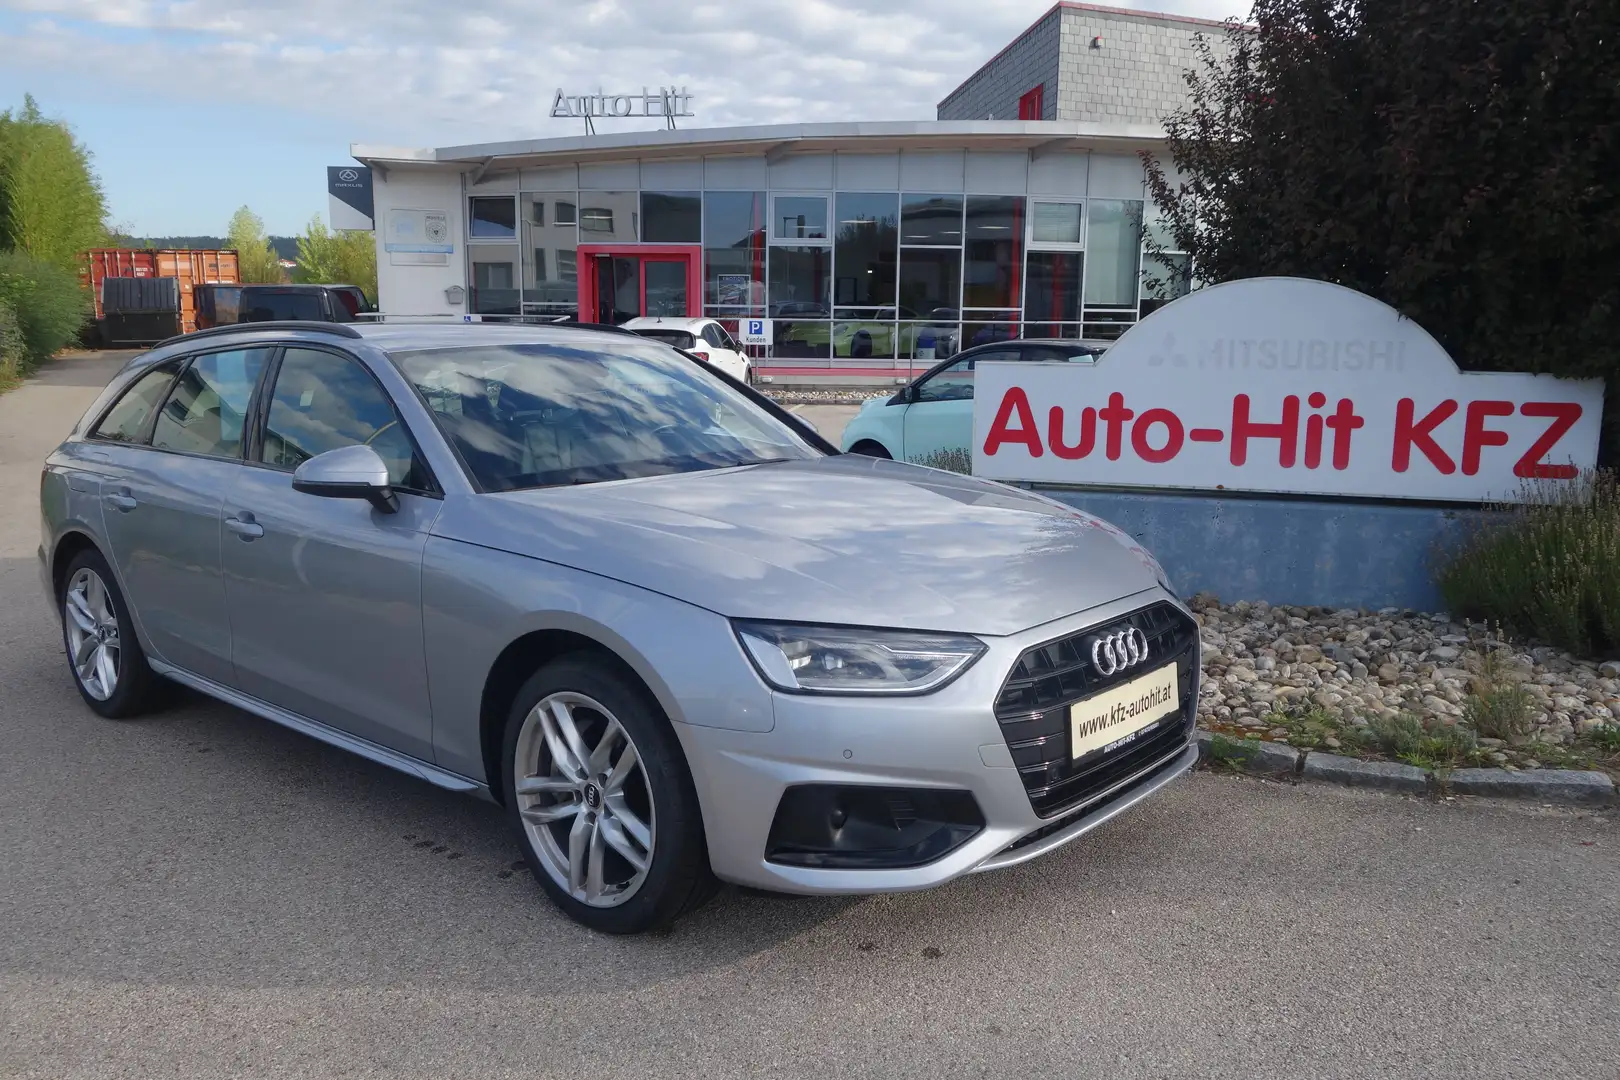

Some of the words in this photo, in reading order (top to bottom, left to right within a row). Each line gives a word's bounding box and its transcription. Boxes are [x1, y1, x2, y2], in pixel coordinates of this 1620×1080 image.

[549, 86, 632, 117] Auto
[643, 85, 694, 117] Hit
[751, 322, 760, 333] P
[1197, 338, 1407, 372] MITSUBISHI
[982, 386, 1365, 471] Auto-Hit
[1390, 397, 1584, 481] KFZ
[1079, 682, 1171, 738] www.kfz-autohit.at
